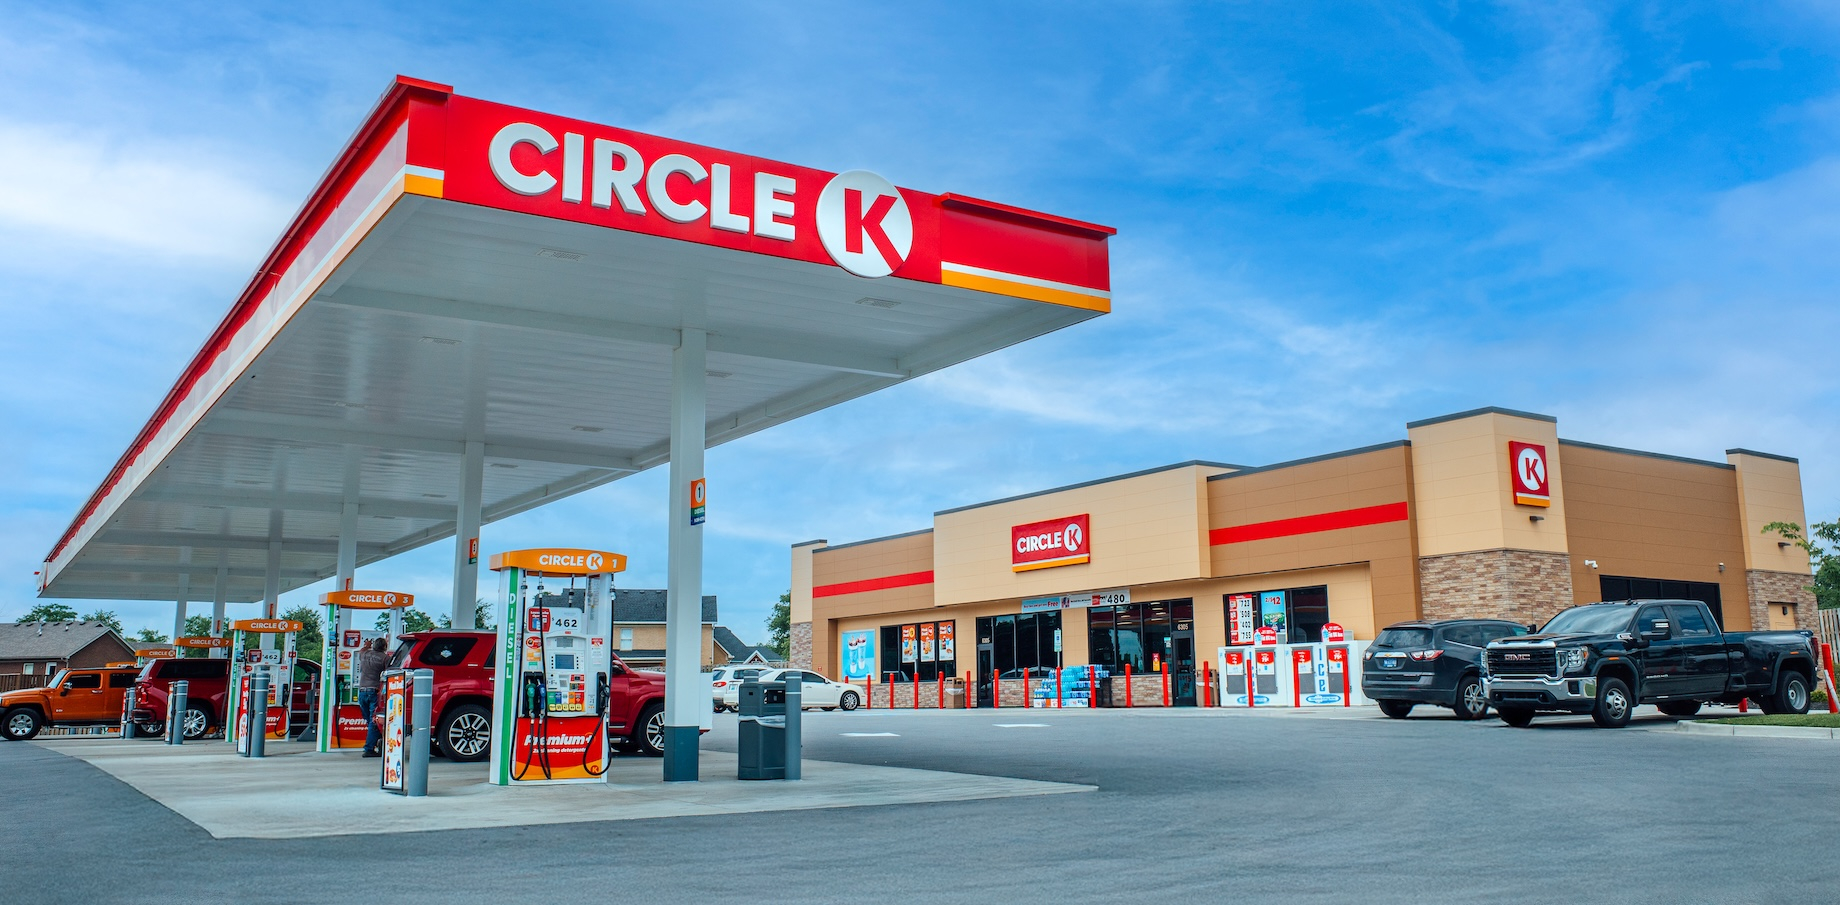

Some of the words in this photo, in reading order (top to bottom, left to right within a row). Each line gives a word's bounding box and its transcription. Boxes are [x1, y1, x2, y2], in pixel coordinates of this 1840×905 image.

[488, 121, 797, 242] CIRCLE
[842, 186, 907, 274] K
[1523, 455, 1543, 488] K
[1016, 531, 1062, 553] CIRCLE
[1067, 527, 1081, 551] K
[539, 554, 585, 567] CIRCLE
[589, 554, 602, 570] K
[612, 559, 618, 569] 1
[349, 594, 382, 603] CIRCLE
[385, 594, 396, 605] K
[402, 596, 409, 604] 3
[279, 622, 287, 631] K
[505, 592, 516, 679] DIESEL
[1504, 653, 1531, 661] GMC
